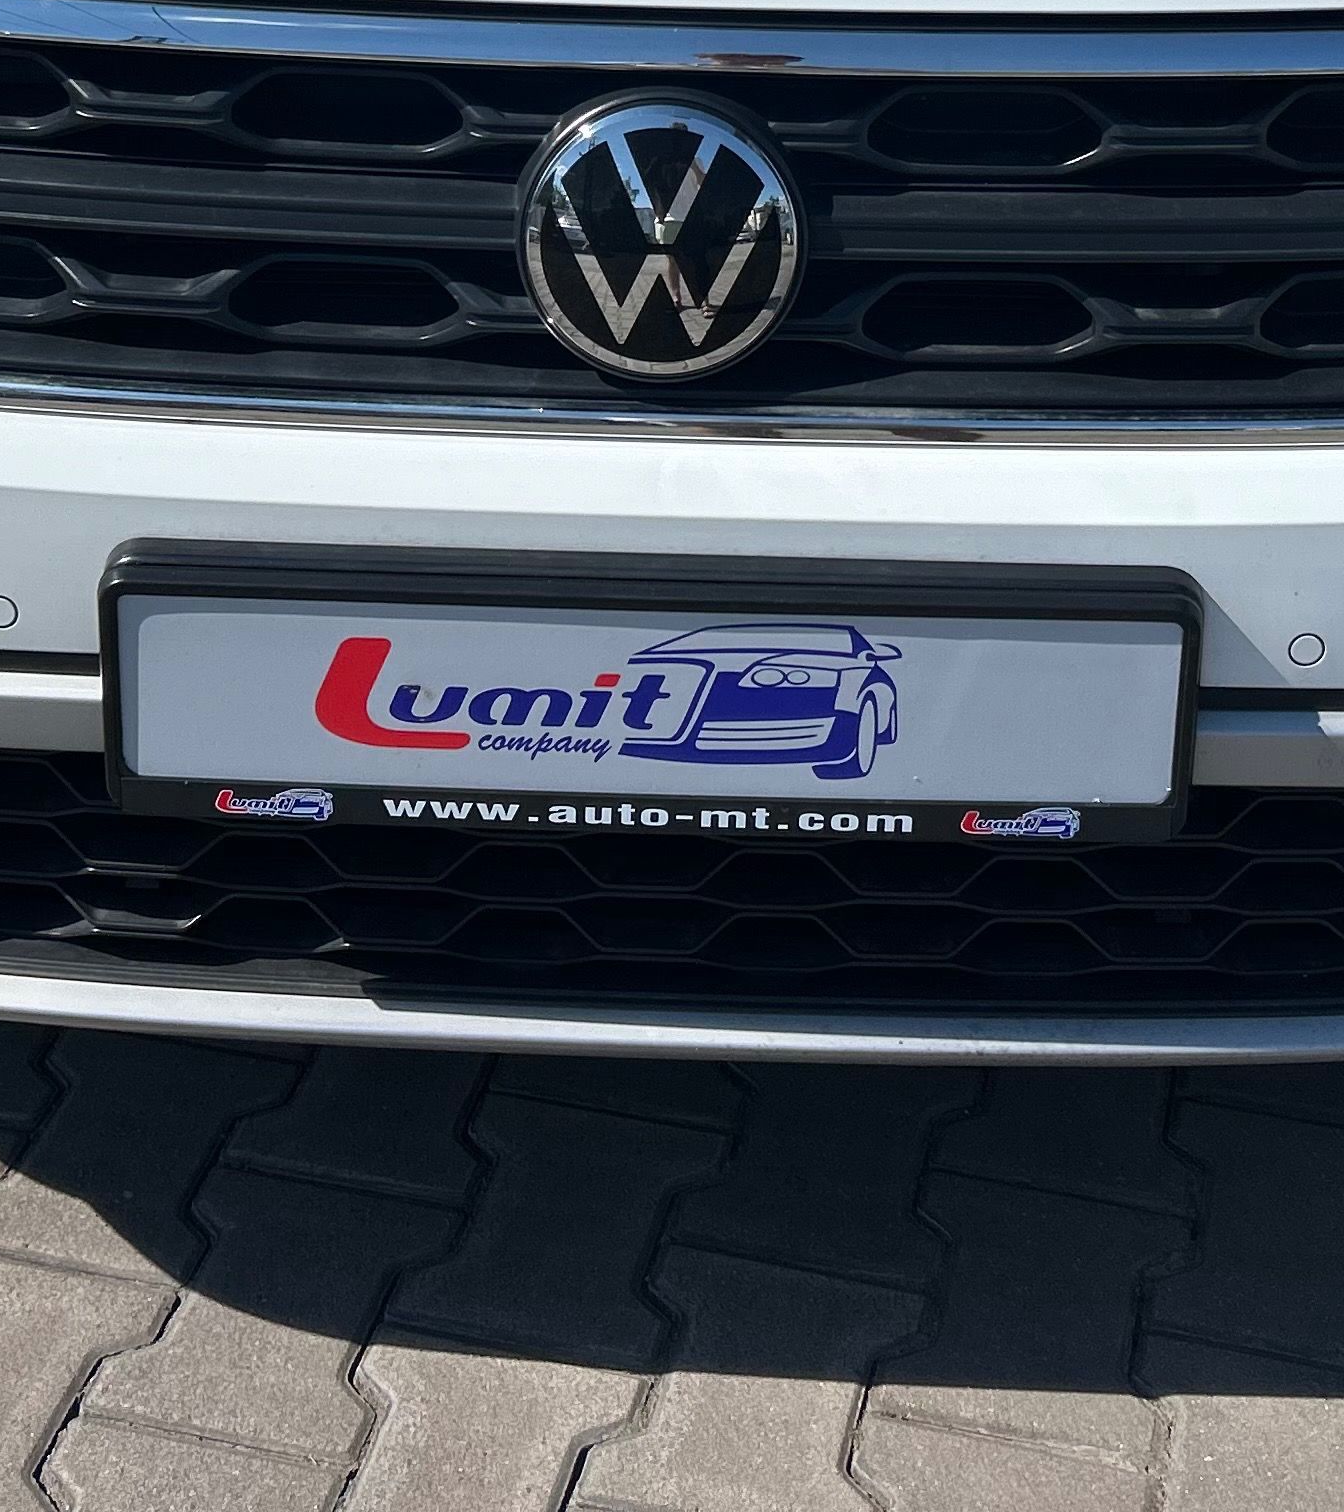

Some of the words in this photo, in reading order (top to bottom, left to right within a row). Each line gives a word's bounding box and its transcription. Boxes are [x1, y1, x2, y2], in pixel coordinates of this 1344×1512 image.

[314, 636, 671, 750] Lumit
[477, 731, 612, 763] company
[382, 798, 915, 833] www.auto-mt.com
